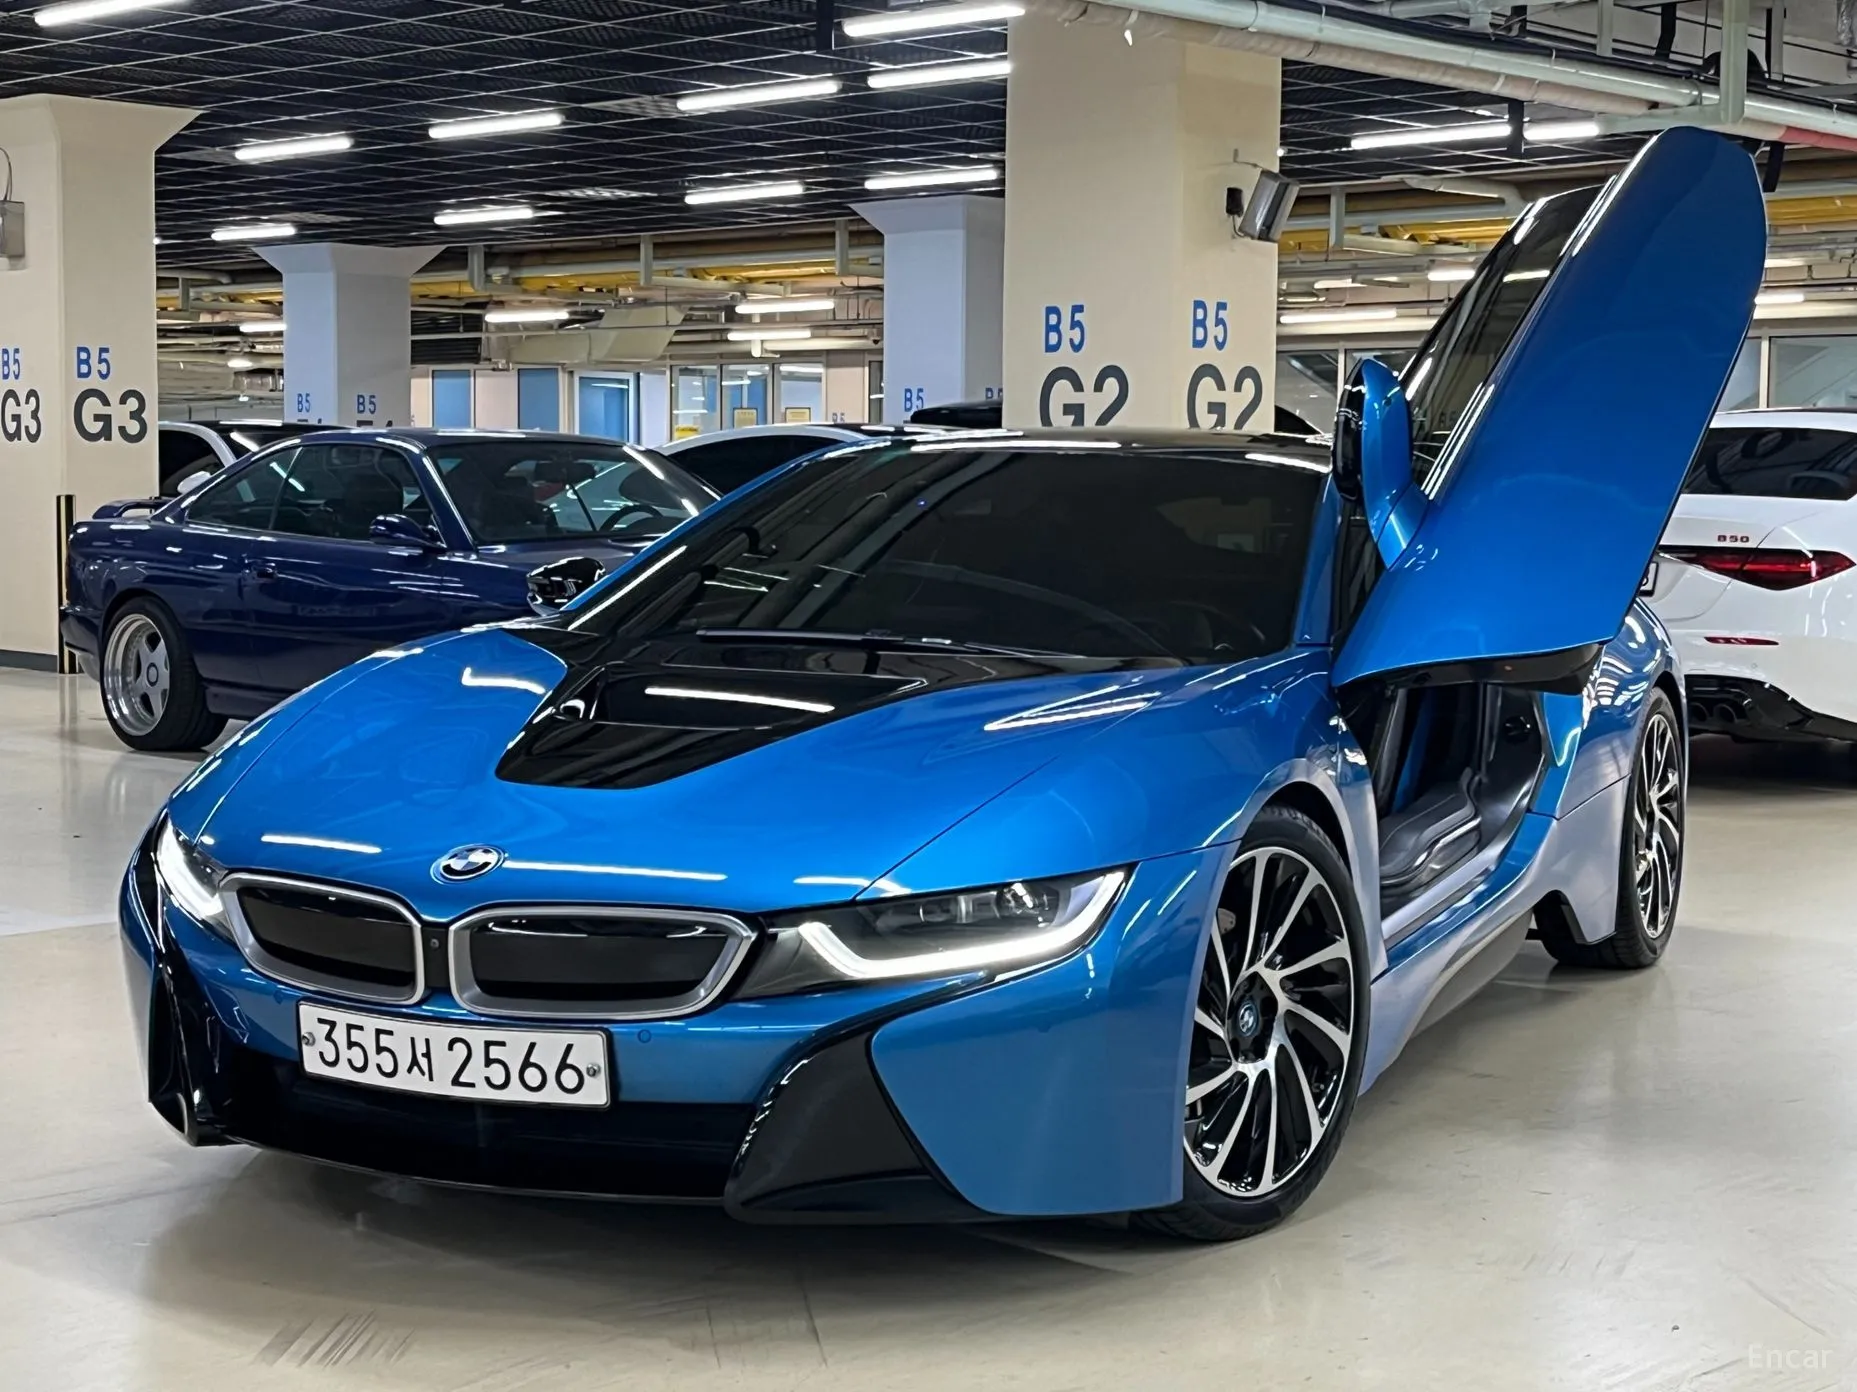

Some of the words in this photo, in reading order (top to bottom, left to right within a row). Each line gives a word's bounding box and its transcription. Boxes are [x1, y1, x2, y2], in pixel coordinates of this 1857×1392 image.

[1045, 304, 1085, 353] B5
[1191, 300, 1228, 351] B5
[1, 348, 20, 380] B5
[76, 346, 111, 380] B5
[1, 388, 41, 443] G3
[73, 388, 148, 443] G3
[297, 393, 311, 413] B5
[356, 394, 377, 414] B5
[904, 387, 924, 412] B5
[1039, 364, 1129, 427] G2
[1187, 363, 1263, 430] G2
[317, 1017, 434, 1082] 355서
[447, 1036, 585, 1095] 2566
